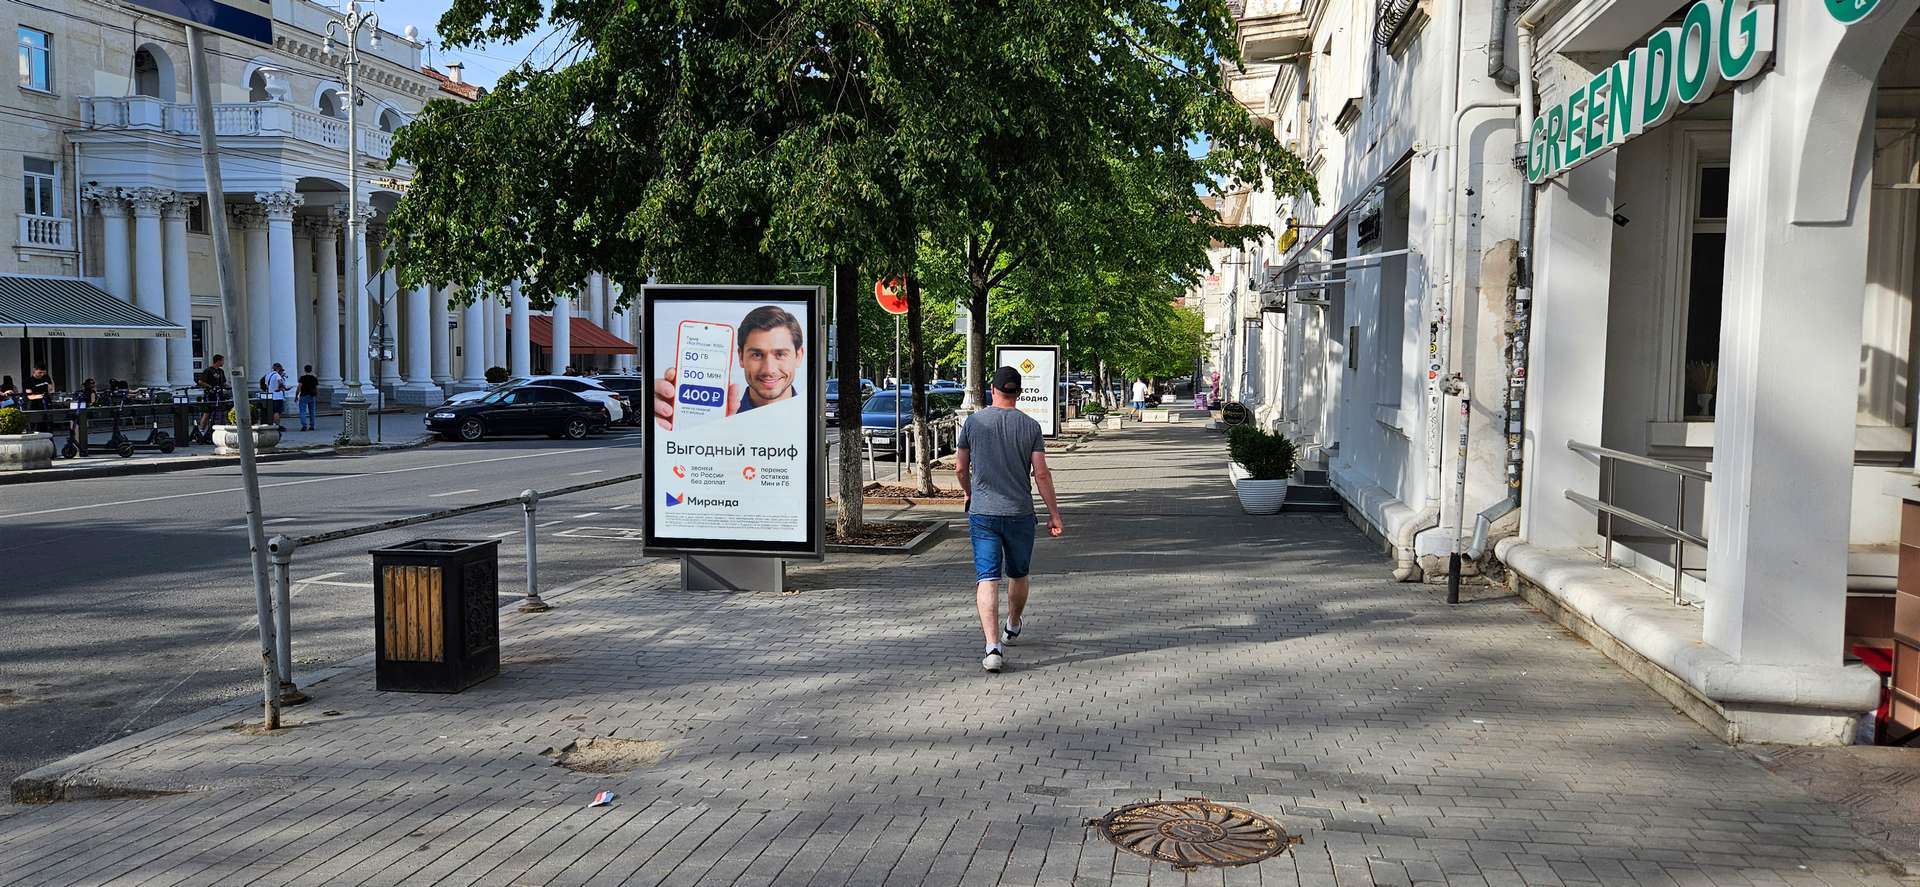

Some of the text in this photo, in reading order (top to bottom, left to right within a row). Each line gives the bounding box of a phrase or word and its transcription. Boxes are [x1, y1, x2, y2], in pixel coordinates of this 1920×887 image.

[685, 351, 699, 361] 50
[683, 369, 704, 380] 500
[682, 388, 710, 402] 400
[666, 441, 799, 460] Выгодный тариф
[700, 471, 725, 479] России
[687, 496, 739, 508] Миранда
